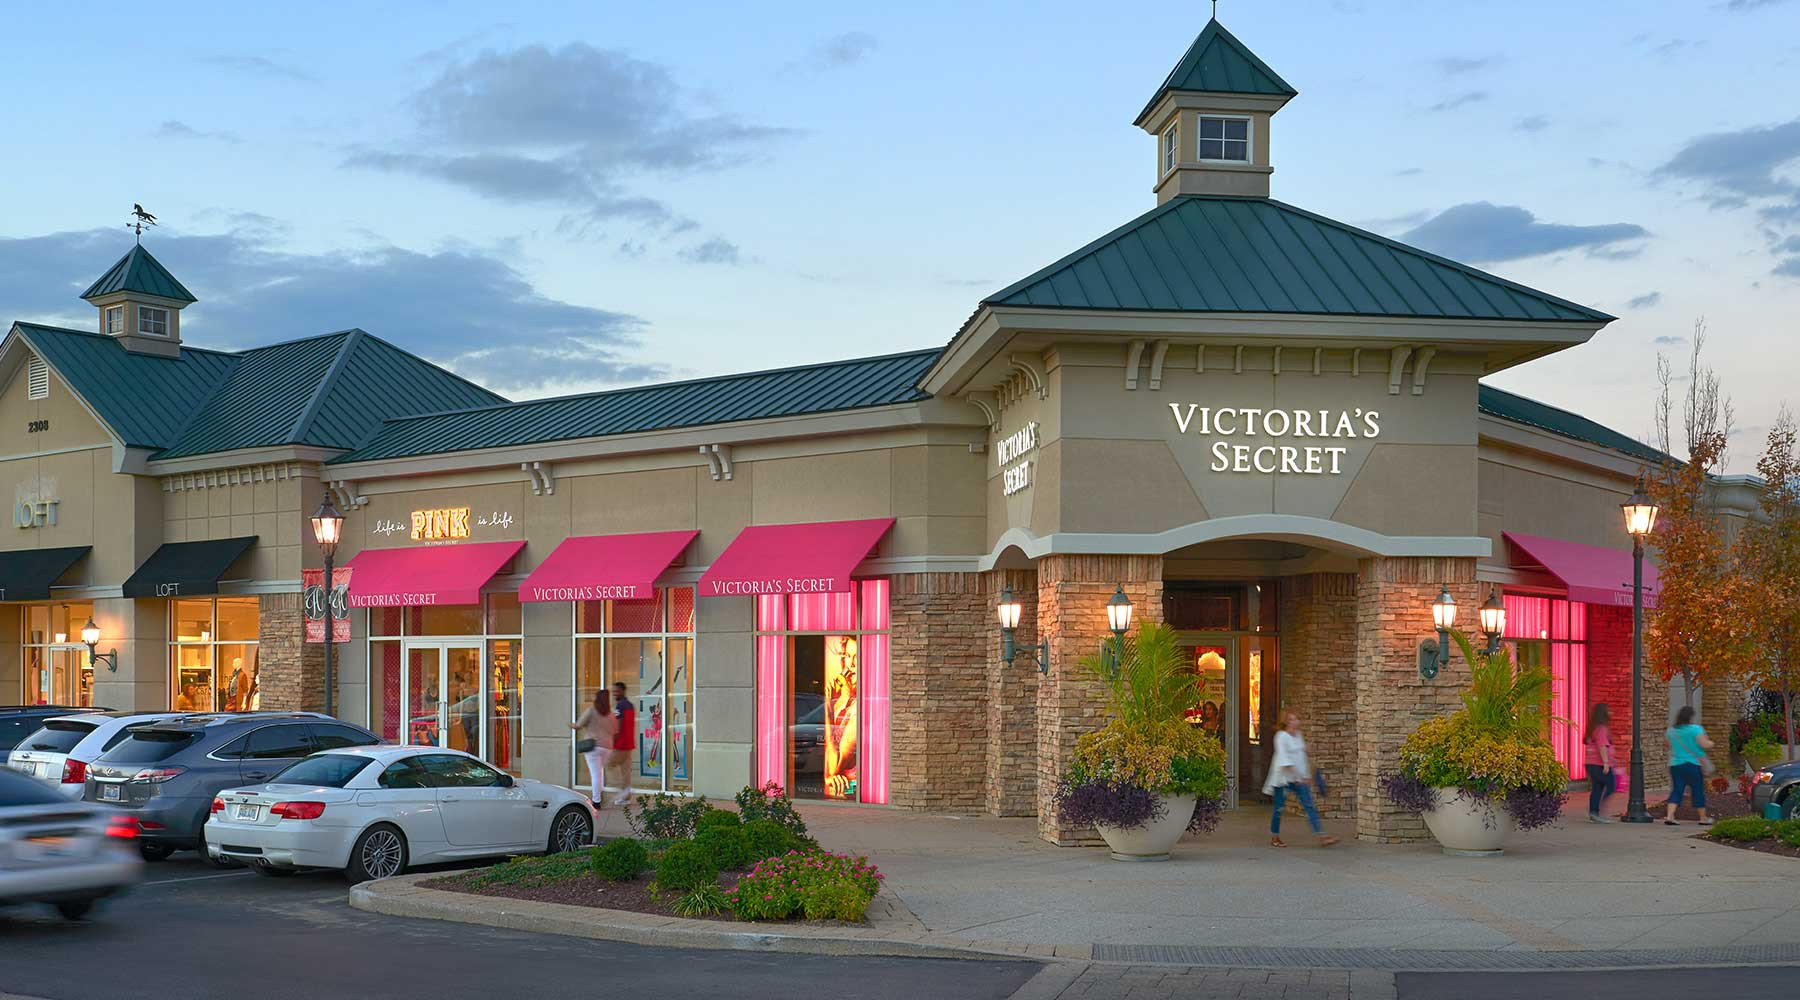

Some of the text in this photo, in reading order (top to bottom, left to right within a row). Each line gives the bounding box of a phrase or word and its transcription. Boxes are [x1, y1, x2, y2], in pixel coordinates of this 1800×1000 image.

[1168, 402, 1380, 438] VICTORIA'S
[997, 421, 1036, 467] VICTORIA'S
[1210, 441, 1347, 474] SECRET
[1003, 460, 1029, 496] SECRET
[373, 520, 395, 536] life
[411, 508, 470, 540] PINK
[488, 512, 513, 528] life
[156, 583, 180, 597] LOFT
[350, 593, 400, 607] VICTORIA'S
[402, 592, 437, 605] SECRET
[533, 585, 636, 600] VICTORIA'S SECRET
[712, 578, 834, 594] VICTORIA'S SECRET
